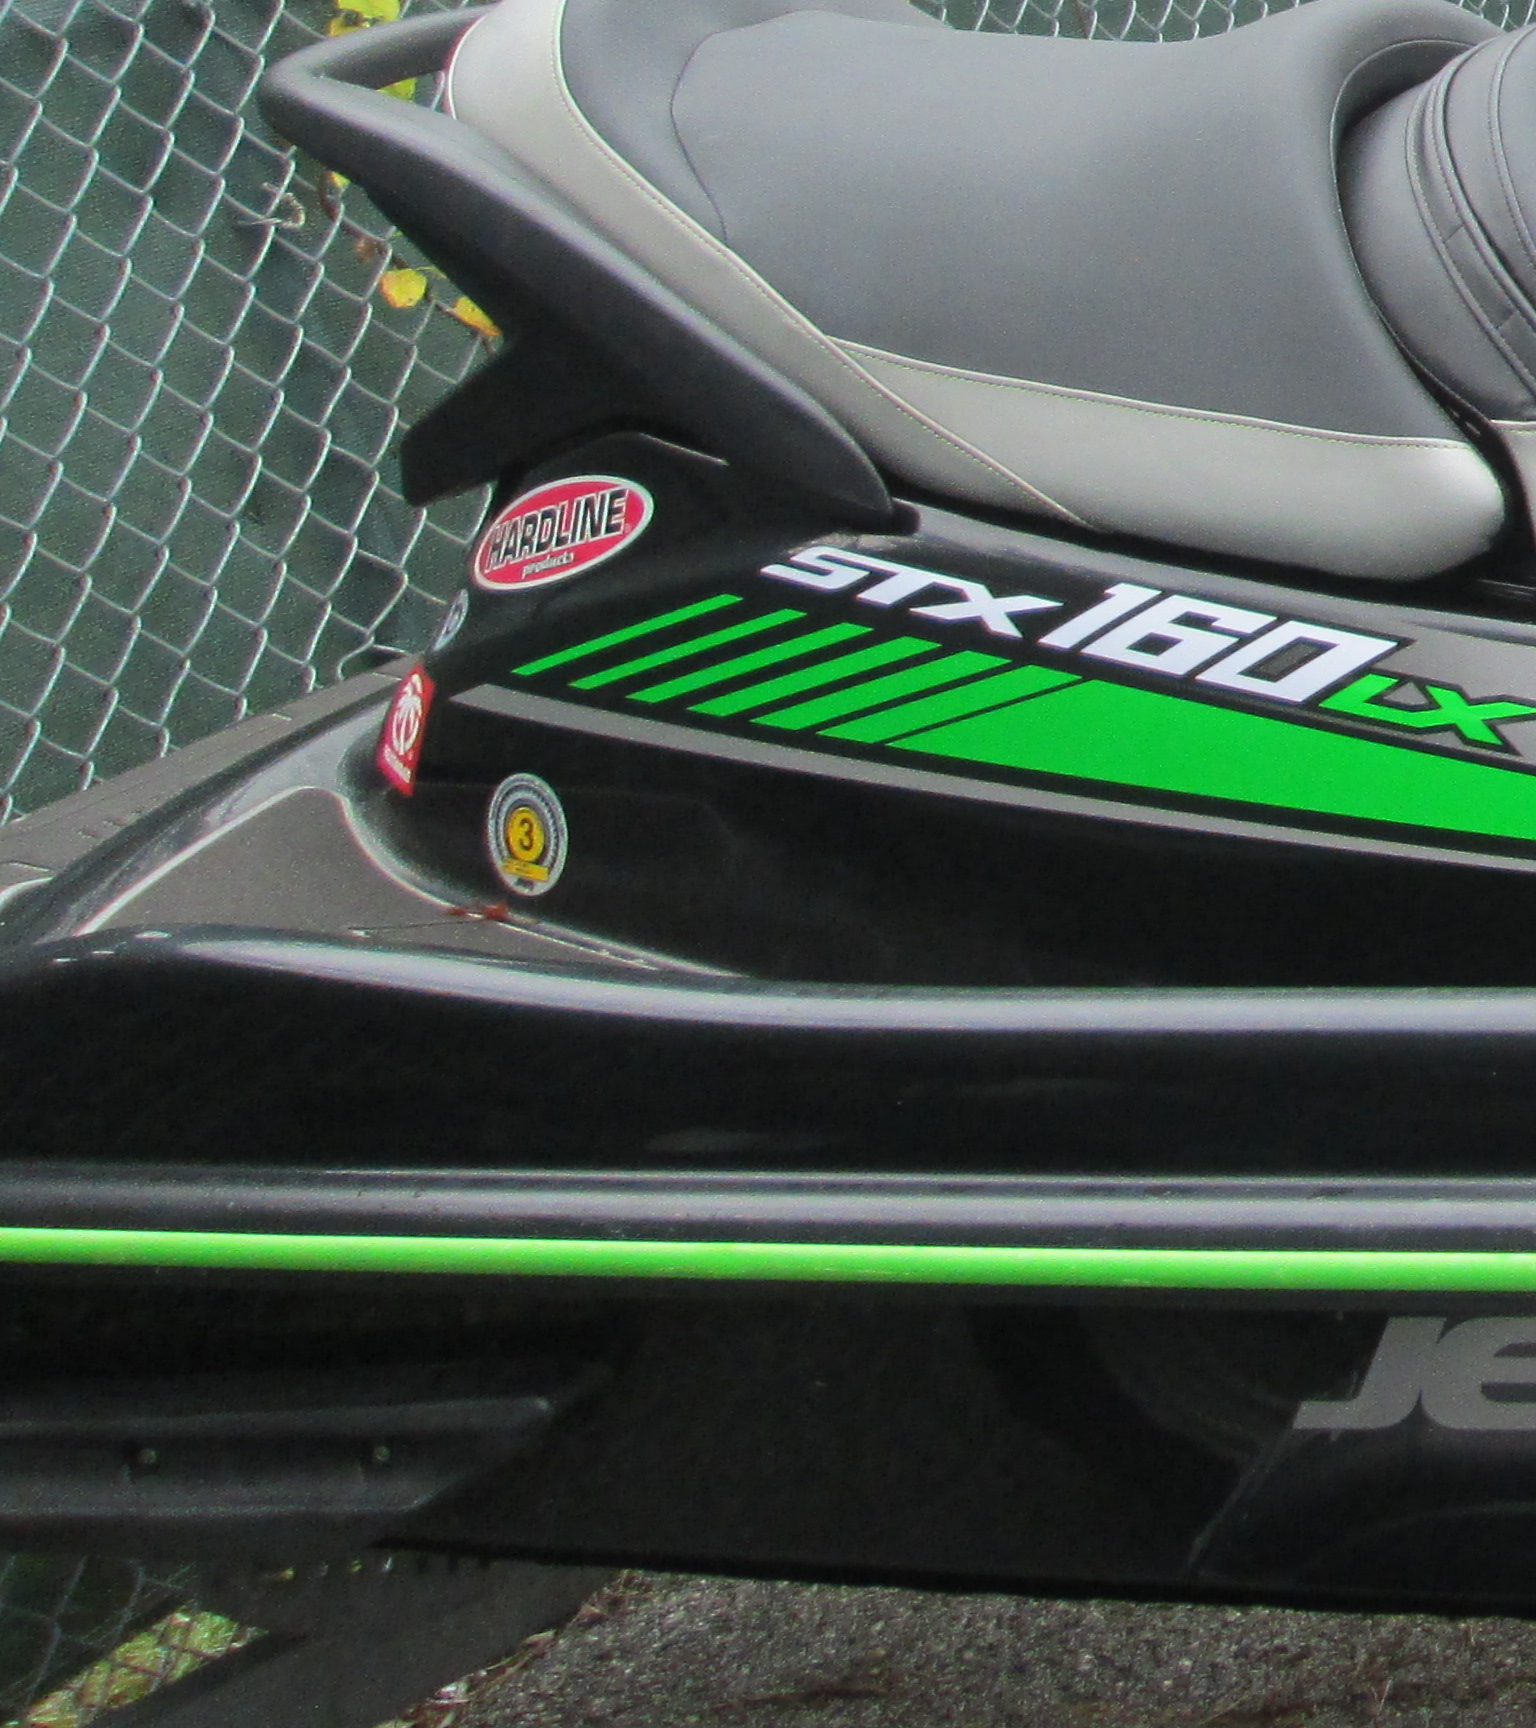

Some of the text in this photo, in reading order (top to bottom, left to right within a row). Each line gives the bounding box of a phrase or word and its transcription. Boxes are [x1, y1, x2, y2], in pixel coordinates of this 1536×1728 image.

[484, 485, 630, 574] HARDLINE
[521, 551, 575, 580] products
[760, 545, 1064, 639] STX
[1038, 582, 1399, 704] 160
[518, 817, 534, 851] 3
